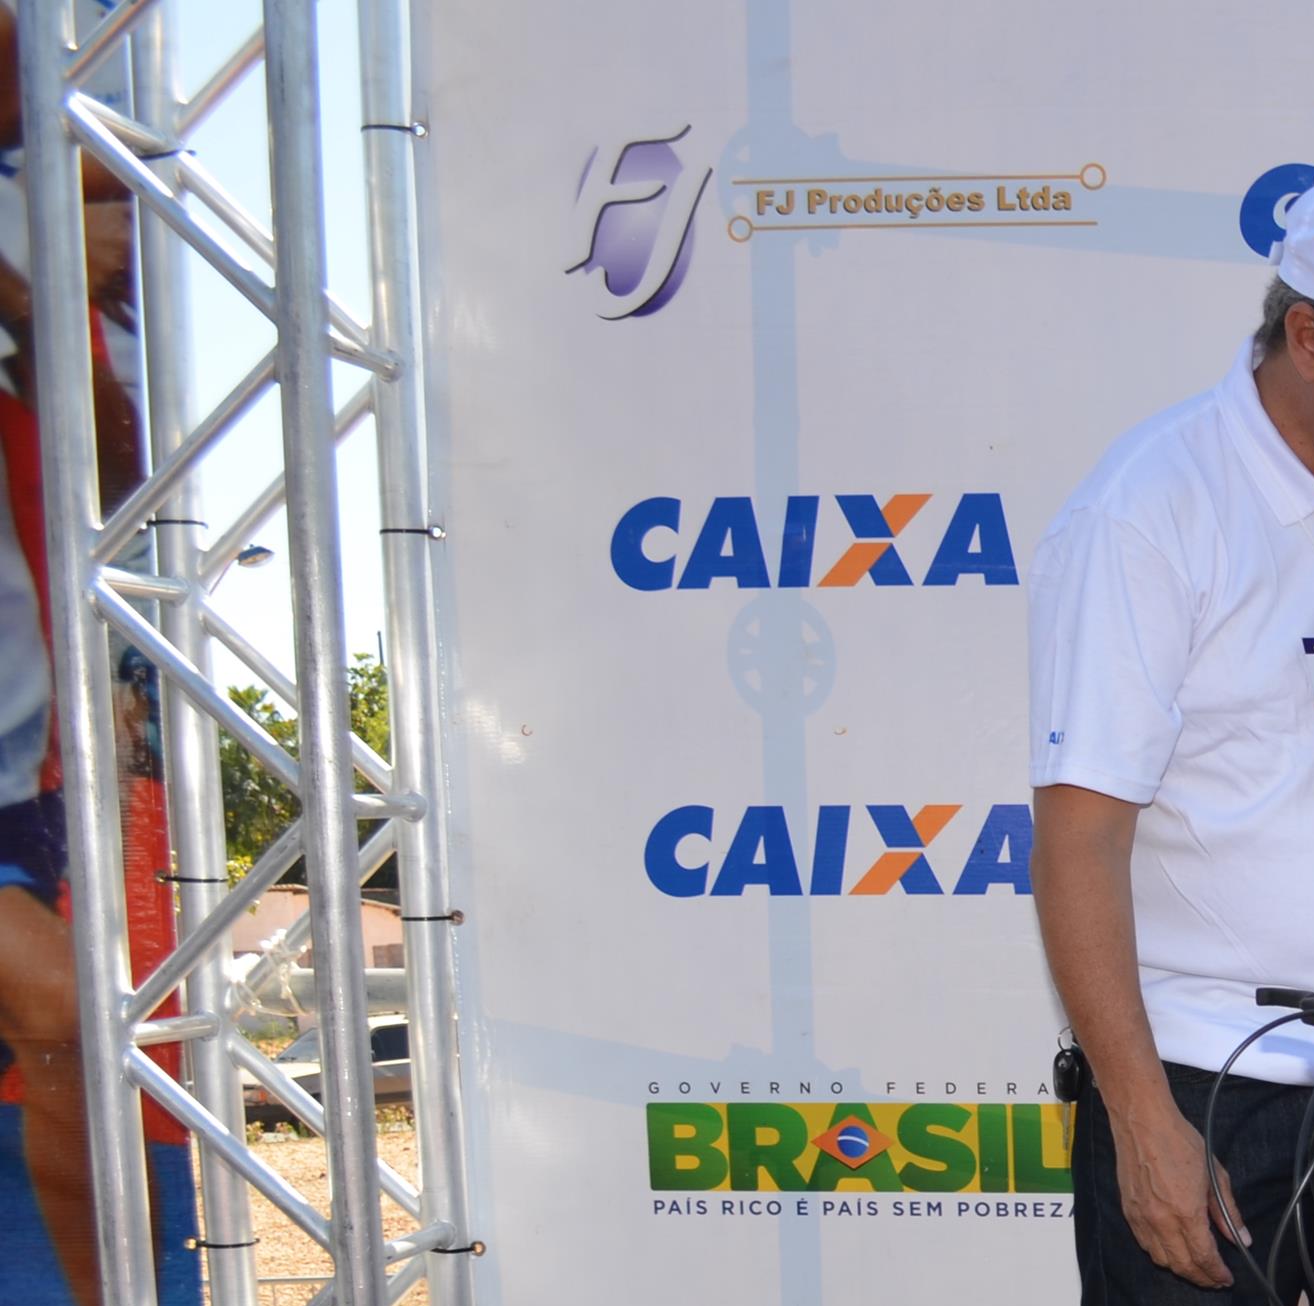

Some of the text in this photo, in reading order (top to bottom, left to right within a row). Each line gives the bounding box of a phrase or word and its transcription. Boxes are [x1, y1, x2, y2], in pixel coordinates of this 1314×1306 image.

[756, 185, 1073, 219] FJ Produções Ltda
[610, 492, 1020, 592] CAIXA
[644, 803, 1034, 898] CAIXA
[647, 1082, 1050, 1095] GOVERNO FEDERA
[646, 1103, 1075, 1193] BRASIL
[652, 1198, 708, 1216] PAÍS
[721, 1200, 782, 1216] RICO
[797, 1198, 809, 1216] É
[823, 1198, 879, 1217] PAÍS
[892, 1201, 943, 1217] SEM
